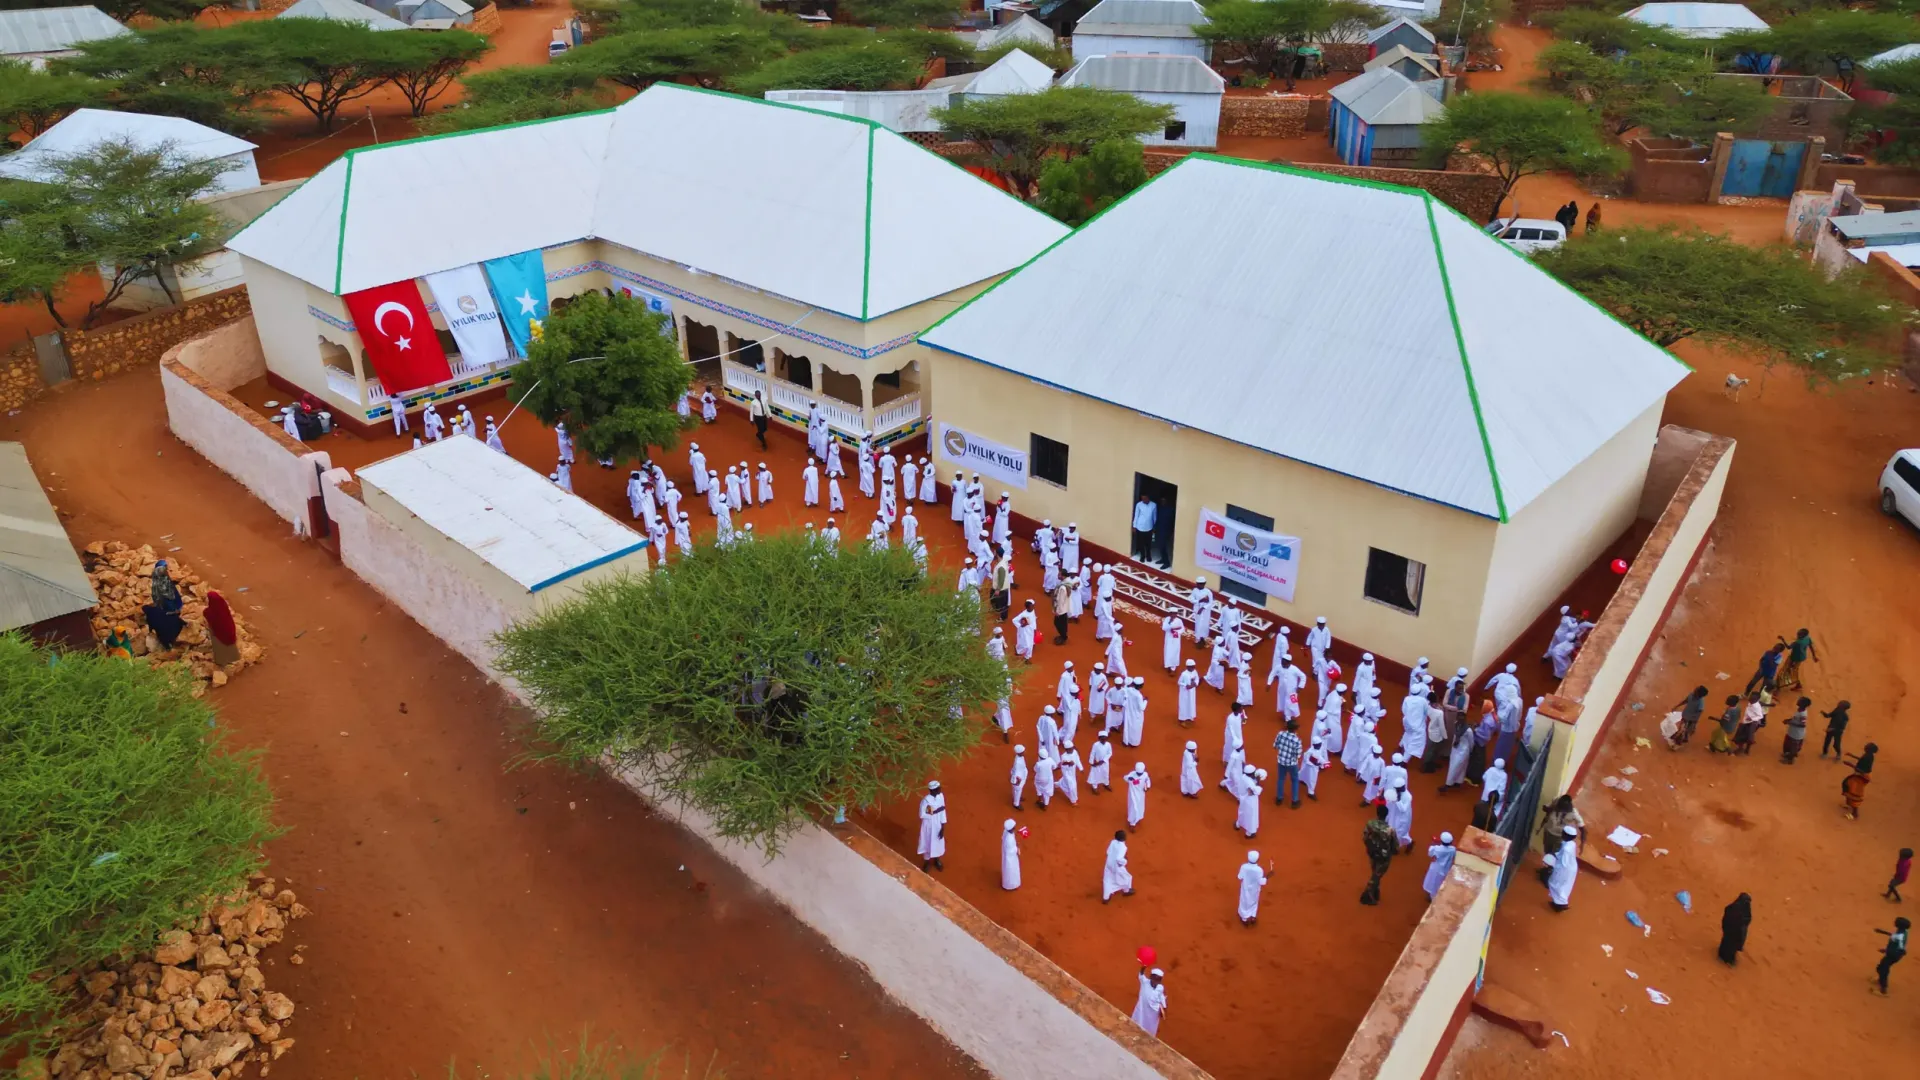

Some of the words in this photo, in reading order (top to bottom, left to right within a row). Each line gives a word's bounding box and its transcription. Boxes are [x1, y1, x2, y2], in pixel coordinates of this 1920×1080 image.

[476, 311, 497, 322] YOLU
[997, 453, 1023, 472] YOLU
[1247, 552, 1269, 567] YOLU
